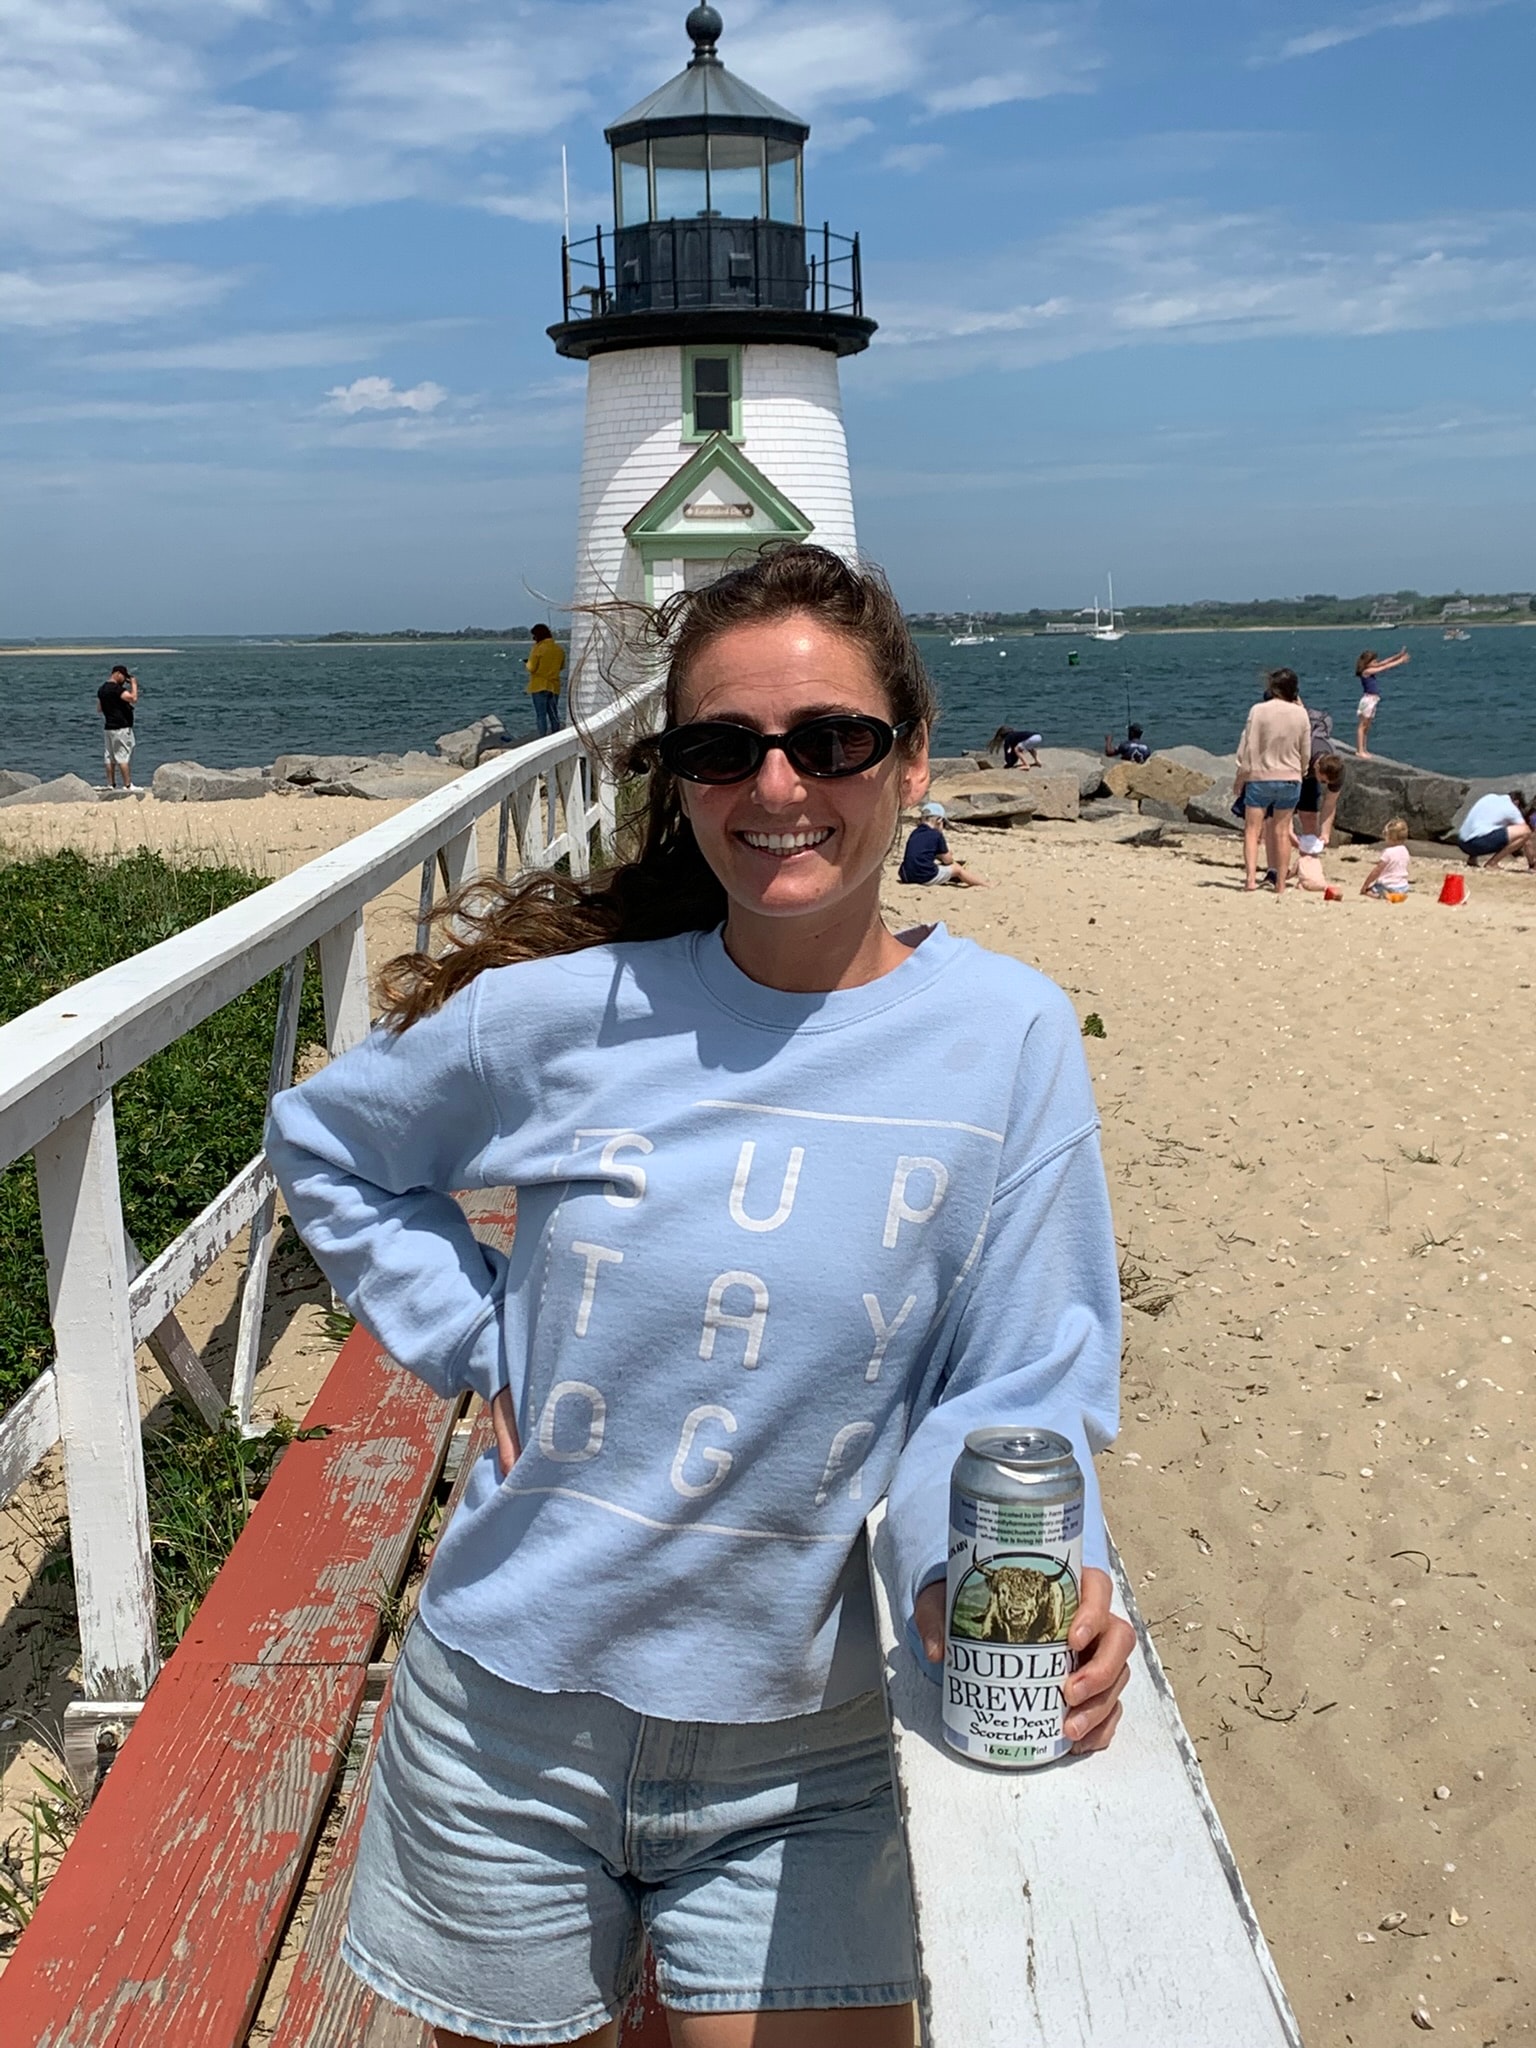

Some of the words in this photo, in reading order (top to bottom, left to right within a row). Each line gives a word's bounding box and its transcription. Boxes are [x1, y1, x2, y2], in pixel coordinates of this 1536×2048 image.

[598, 1134, 653, 1208] S
[728, 1141, 805, 1232] U
[571, 1241, 624, 1339] T
[699, 1271, 769, 1370] A
[862, 1293, 917, 1384] Y
[670, 1405, 738, 1499] G
[952, 1644, 1077, 1680] DUDLEY
[948, 1675, 1067, 1713] BREWIN
[969, 1722, 1033, 1741] Scottish
[1037, 1727, 1061, 1740] Ale
[974, 1709, 1009, 1728] Wee
[1013, 1715, 1059, 1729] Heavy
[984, 1743, 994, 1754] 16
[1031, 1745, 1048, 1756] Pint
